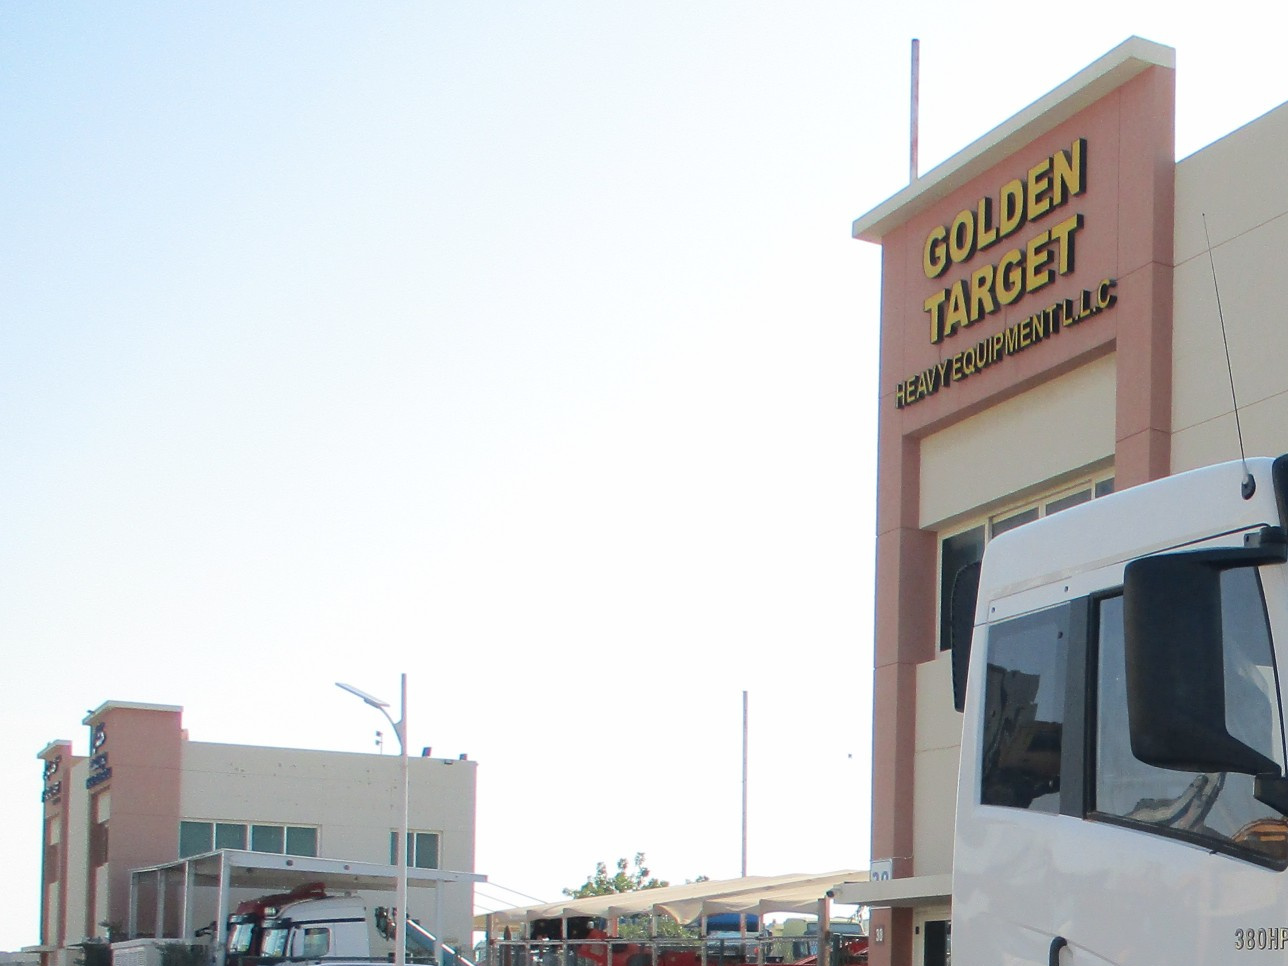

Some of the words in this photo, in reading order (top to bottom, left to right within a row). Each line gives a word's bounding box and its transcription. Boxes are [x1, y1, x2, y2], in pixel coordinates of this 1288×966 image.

[923, 138, 1087, 280] GOLDEN
[924, 214, 1084, 344] TARGET
[895, 360, 950, 409] HEAVY
[952, 304, 1060, 382] EQUIPMENT
